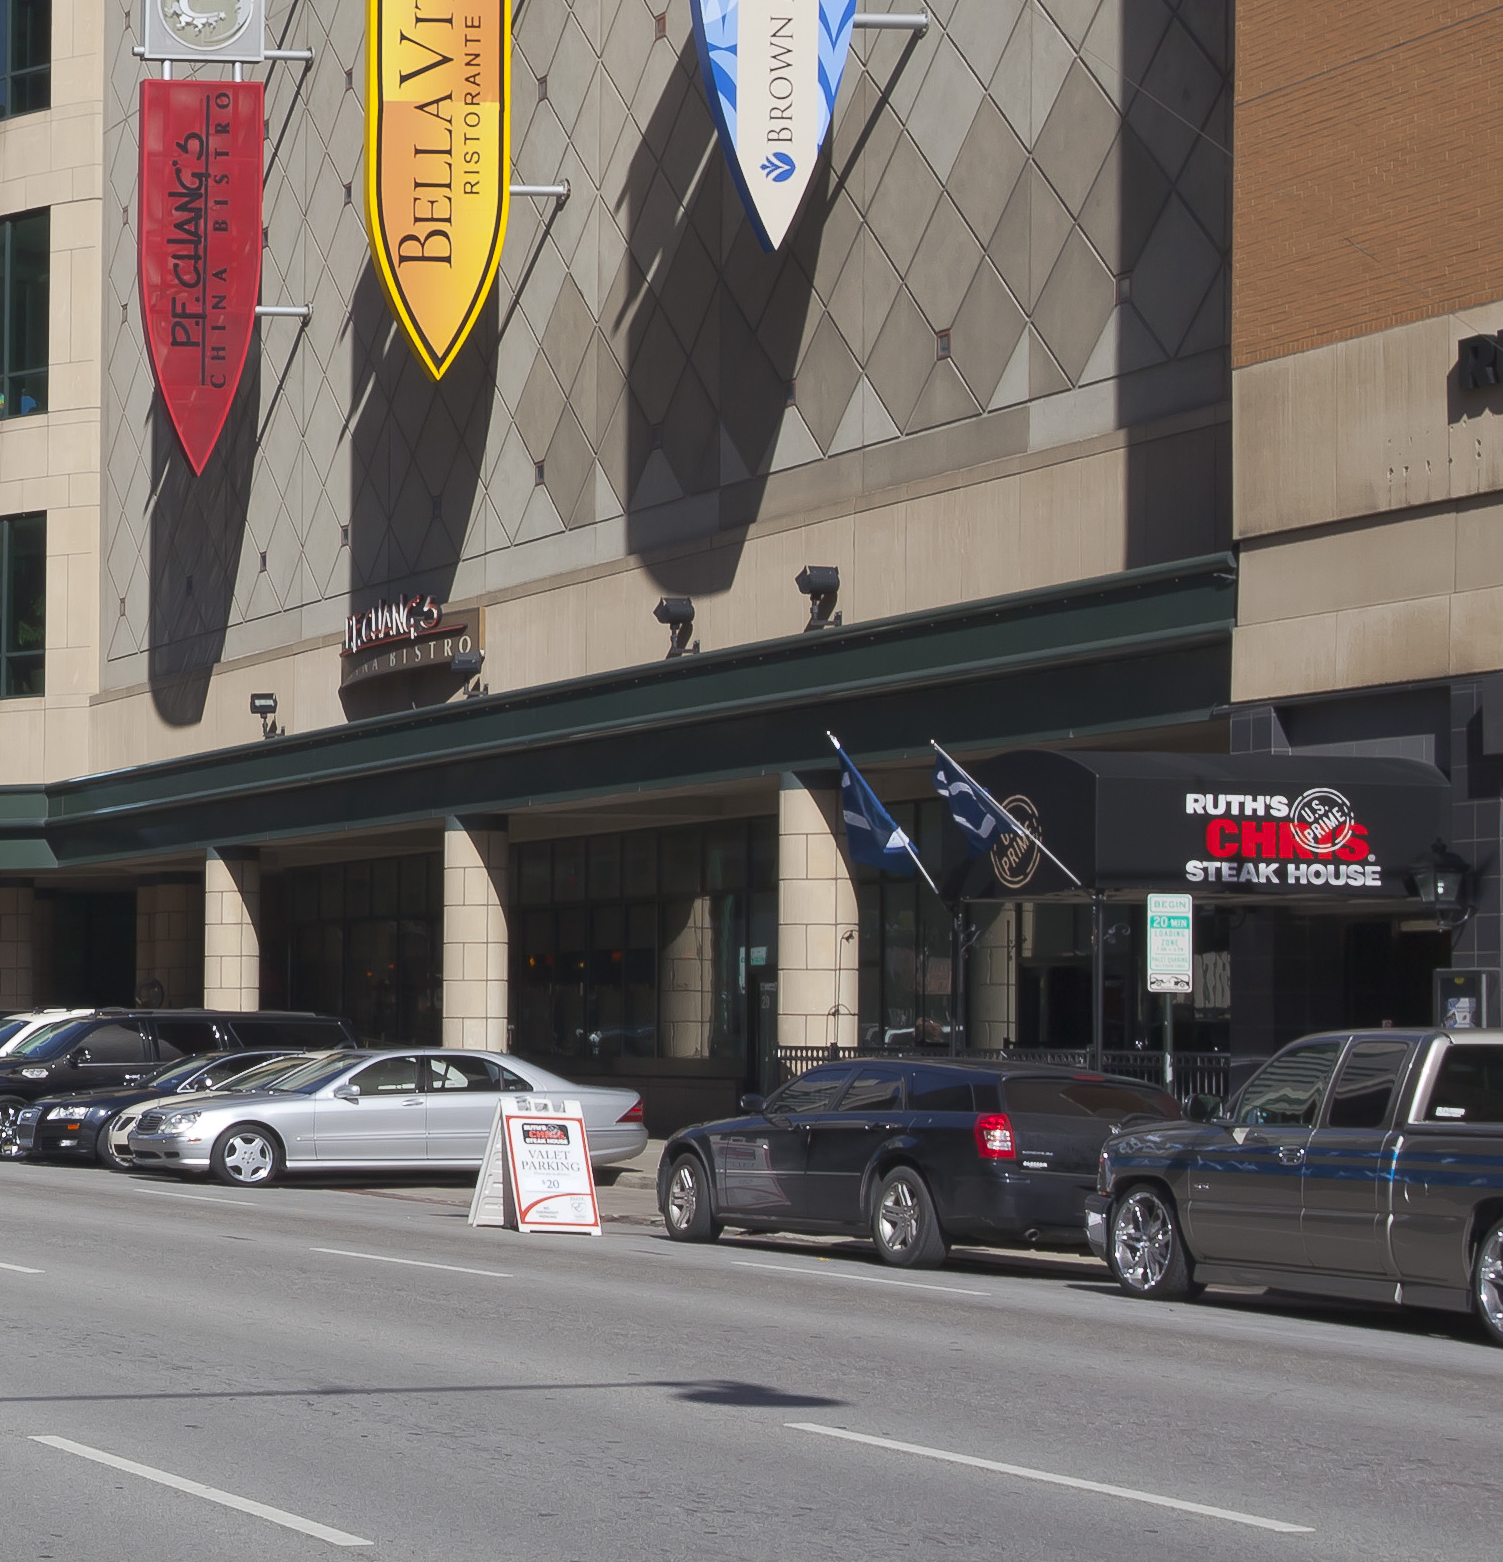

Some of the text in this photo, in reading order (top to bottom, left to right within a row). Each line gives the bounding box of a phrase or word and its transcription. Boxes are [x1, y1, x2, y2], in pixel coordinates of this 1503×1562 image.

[767, 16, 794, 144] BROWN
[463, 14, 482, 195] RISTORANTE
[398, 90, 453, 269] BELLA
[210, 92, 231, 389] CHINA BISTRO
[389, 635, 472, 668] BISTRO
[1185, 793, 1290, 817] RUTH'S
[1301, 799, 1329, 823] U.S.
[1304, 806, 1346, 845] PRIME
[1206, 818, 1370, 862] CHRIS
[1185, 859, 1382, 887] STEAK HOUSE
[1153, 900, 1187, 909] BEGIN
[1153, 916, 1187, 928] 20 MIN
[1154, 929, 1186, 938] LOADING
[1161, 939, 1179, 947] ZONE
[521, 1160, 580, 1172] PARKING
[528, 1149, 571, 1160] VALET
[542, 1179, 560, 1189] $20
